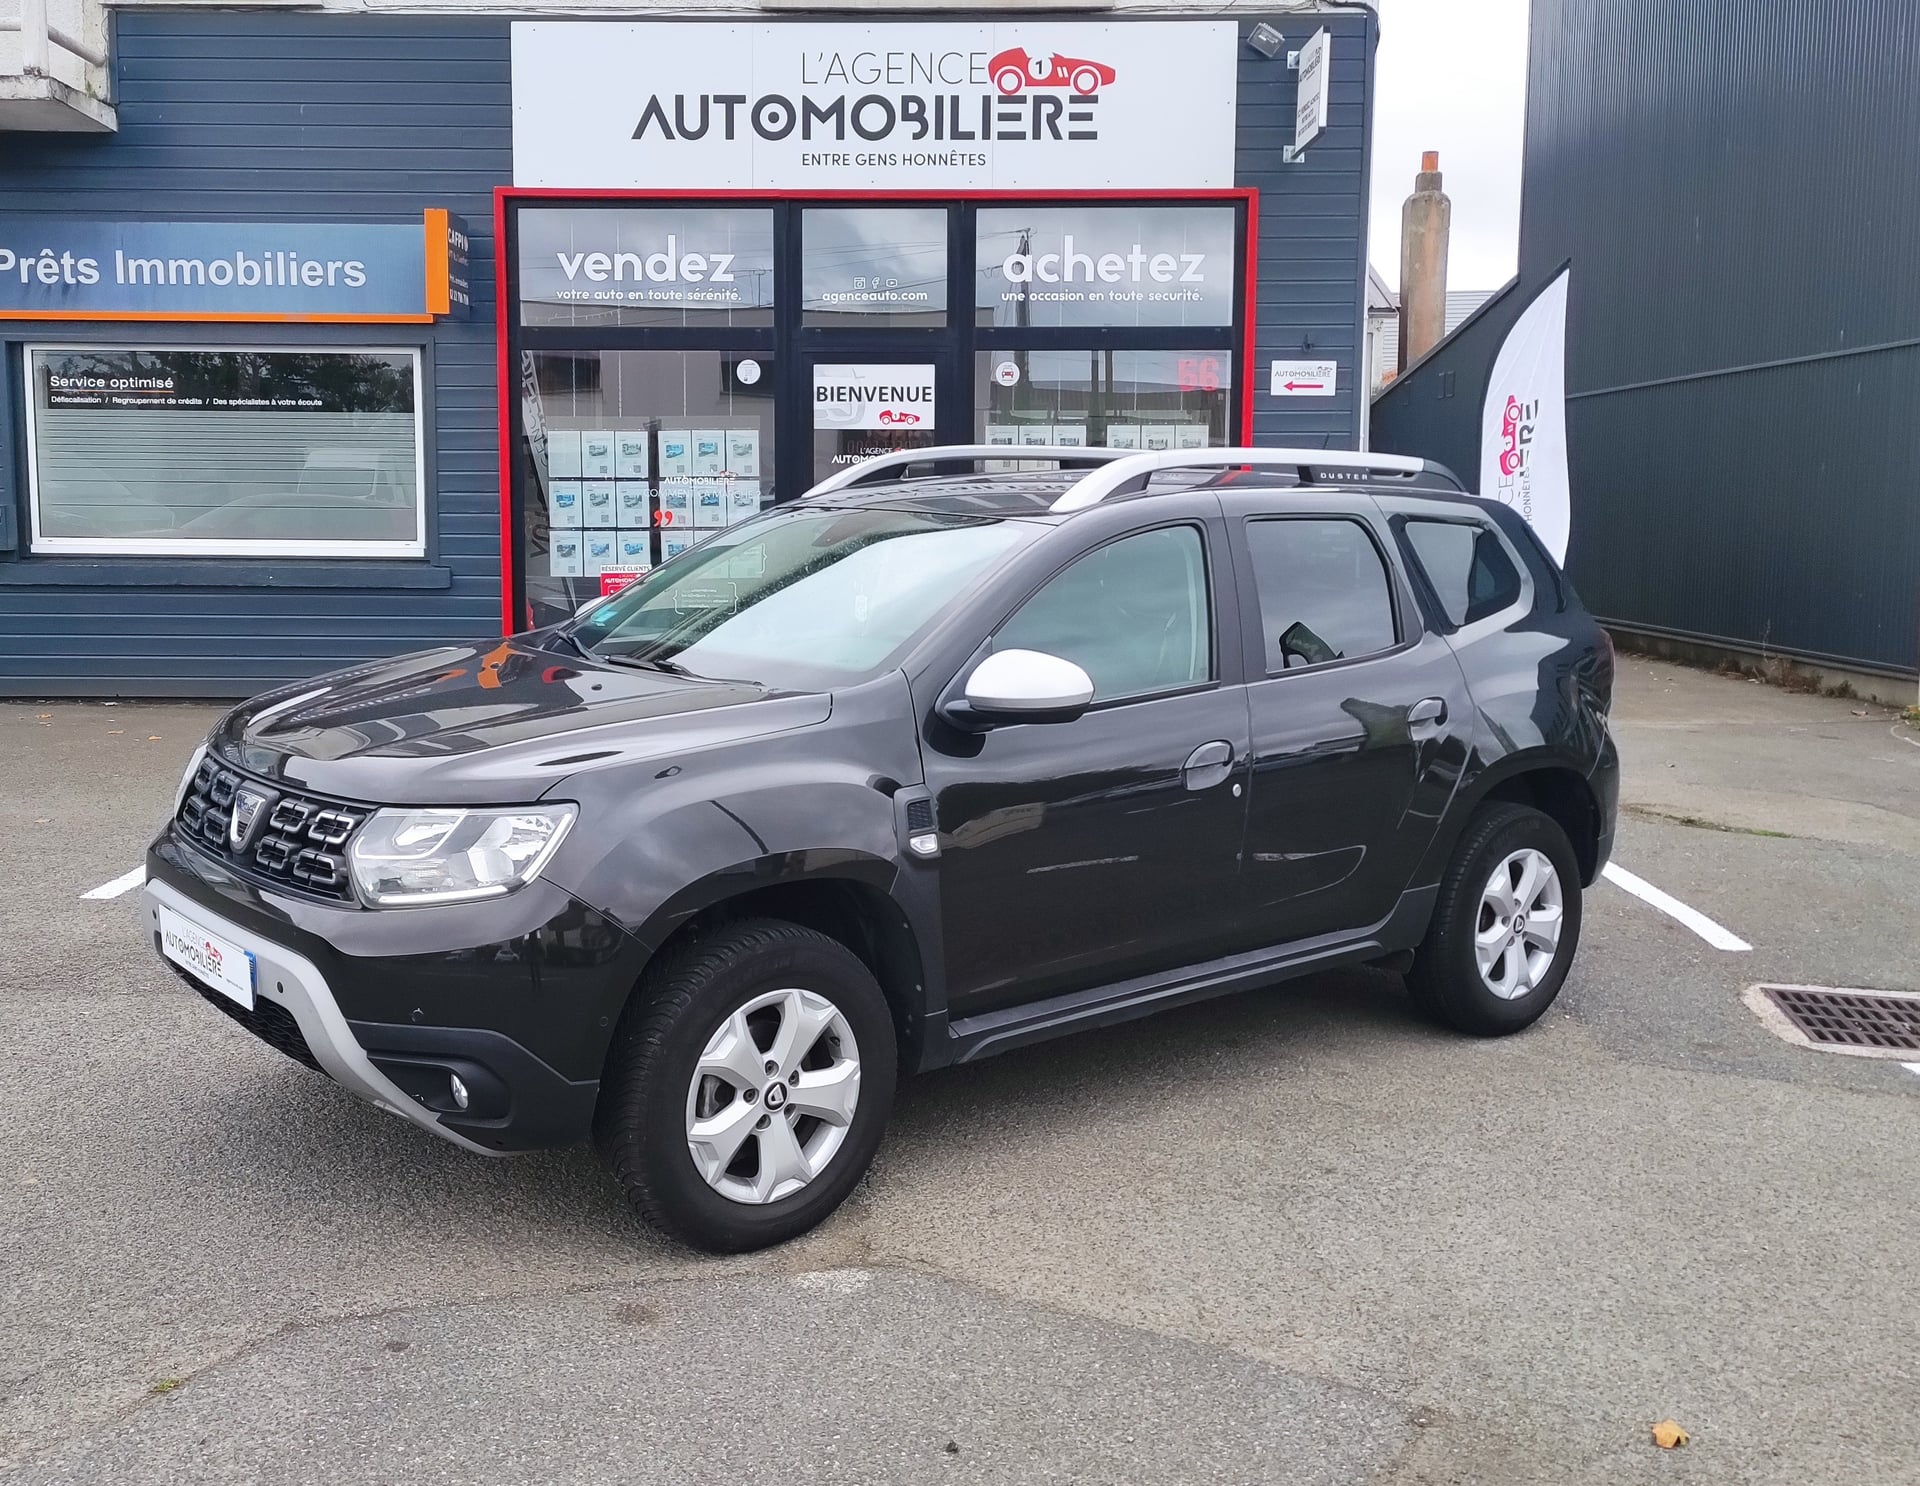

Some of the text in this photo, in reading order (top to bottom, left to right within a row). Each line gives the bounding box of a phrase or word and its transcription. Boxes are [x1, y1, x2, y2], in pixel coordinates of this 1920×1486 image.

[802, 51, 988, 85] L'AGENCE
[802, 149, 986, 167] ENTRE GENS HONNÊTES
[556, 234, 736, 282] vendez
[1002, 235, 1206, 283] achetez
[115, 249, 367, 287] Immobiliers
[556, 288, 742, 301] votre auto en toute sérénité.
[822, 290, 928, 305] agenceauto.com
[1001, 292, 1026, 301] une
[1029, 289, 1084, 301] occasion
[1088, 292, 1105, 301] en
[1108, 289, 1144, 301] toute
[50, 376, 174, 391] Service optimisé
[167, 397, 177, 405] de
[178, 397, 203, 405] crédits
[816, 386, 933, 402] BIENVENUE
[860, 447, 893, 455] L'AGENCE
[1320, 472, 1368, 481] DUSTER
